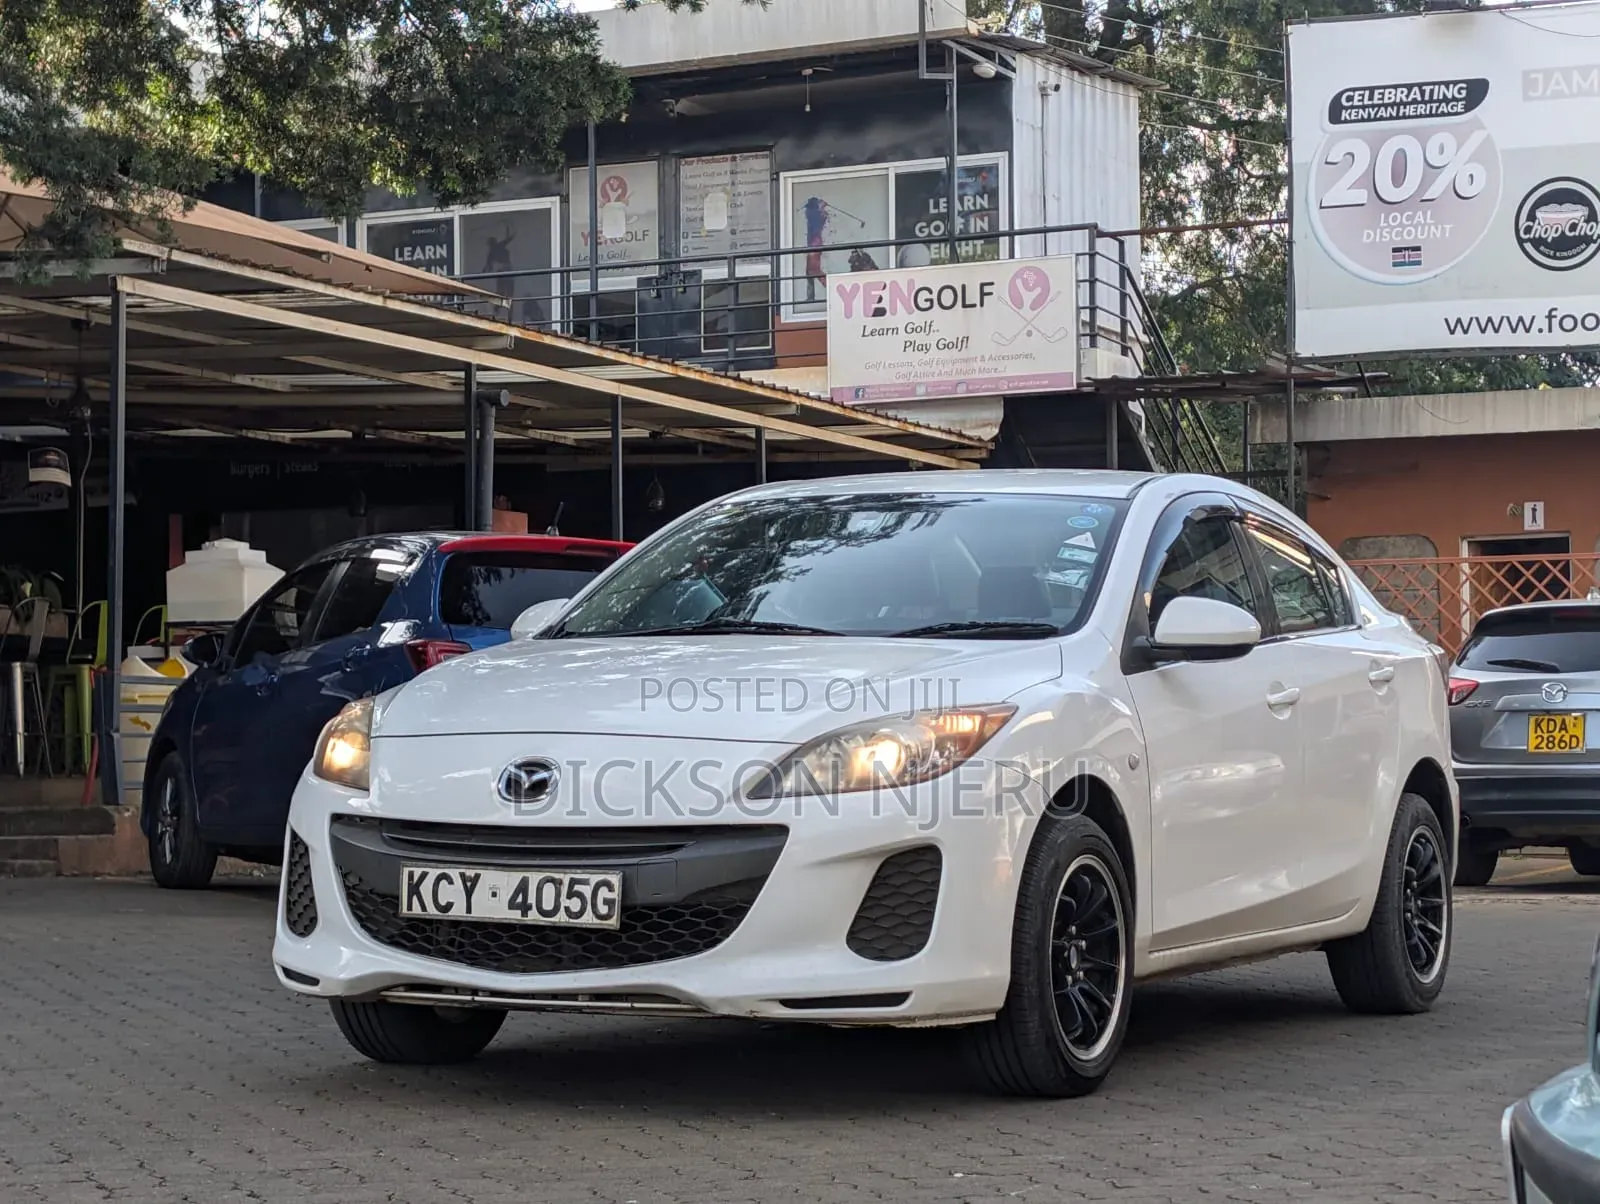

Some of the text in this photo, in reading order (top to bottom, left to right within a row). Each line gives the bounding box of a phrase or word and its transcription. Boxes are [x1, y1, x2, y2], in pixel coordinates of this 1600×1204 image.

[1341, 83, 1467, 106] CELEBRATING
[1341, 101, 1466, 120] KENYAN HERITAGE
[1319, 129, 1488, 209] 20%
[928, 193, 989, 213] LEARN
[970, 216, 989, 233] IN
[1380, 210, 1435, 227] LOCAL
[1363, 224, 1453, 243] DISCOUNT
[1520, 218, 1562, 242] Chop
[394, 243, 448, 262] LEARN
[861, 320, 940, 337] Learn Golf..
[903, 335, 969, 354] Play Golf!
[864, 361, 882, 371] Golf
[917, 357, 934, 368] Golf
[935, 355, 978, 366] Equipment
[895, 371, 913, 382] Golf
[937, 368, 954, 378] And
[955, 367, 976, 377] Much
[1534, 717, 1569, 734] KDA
[1534, 735, 1580, 750] 286D
[406, 870, 617, 921] KCY 405G
